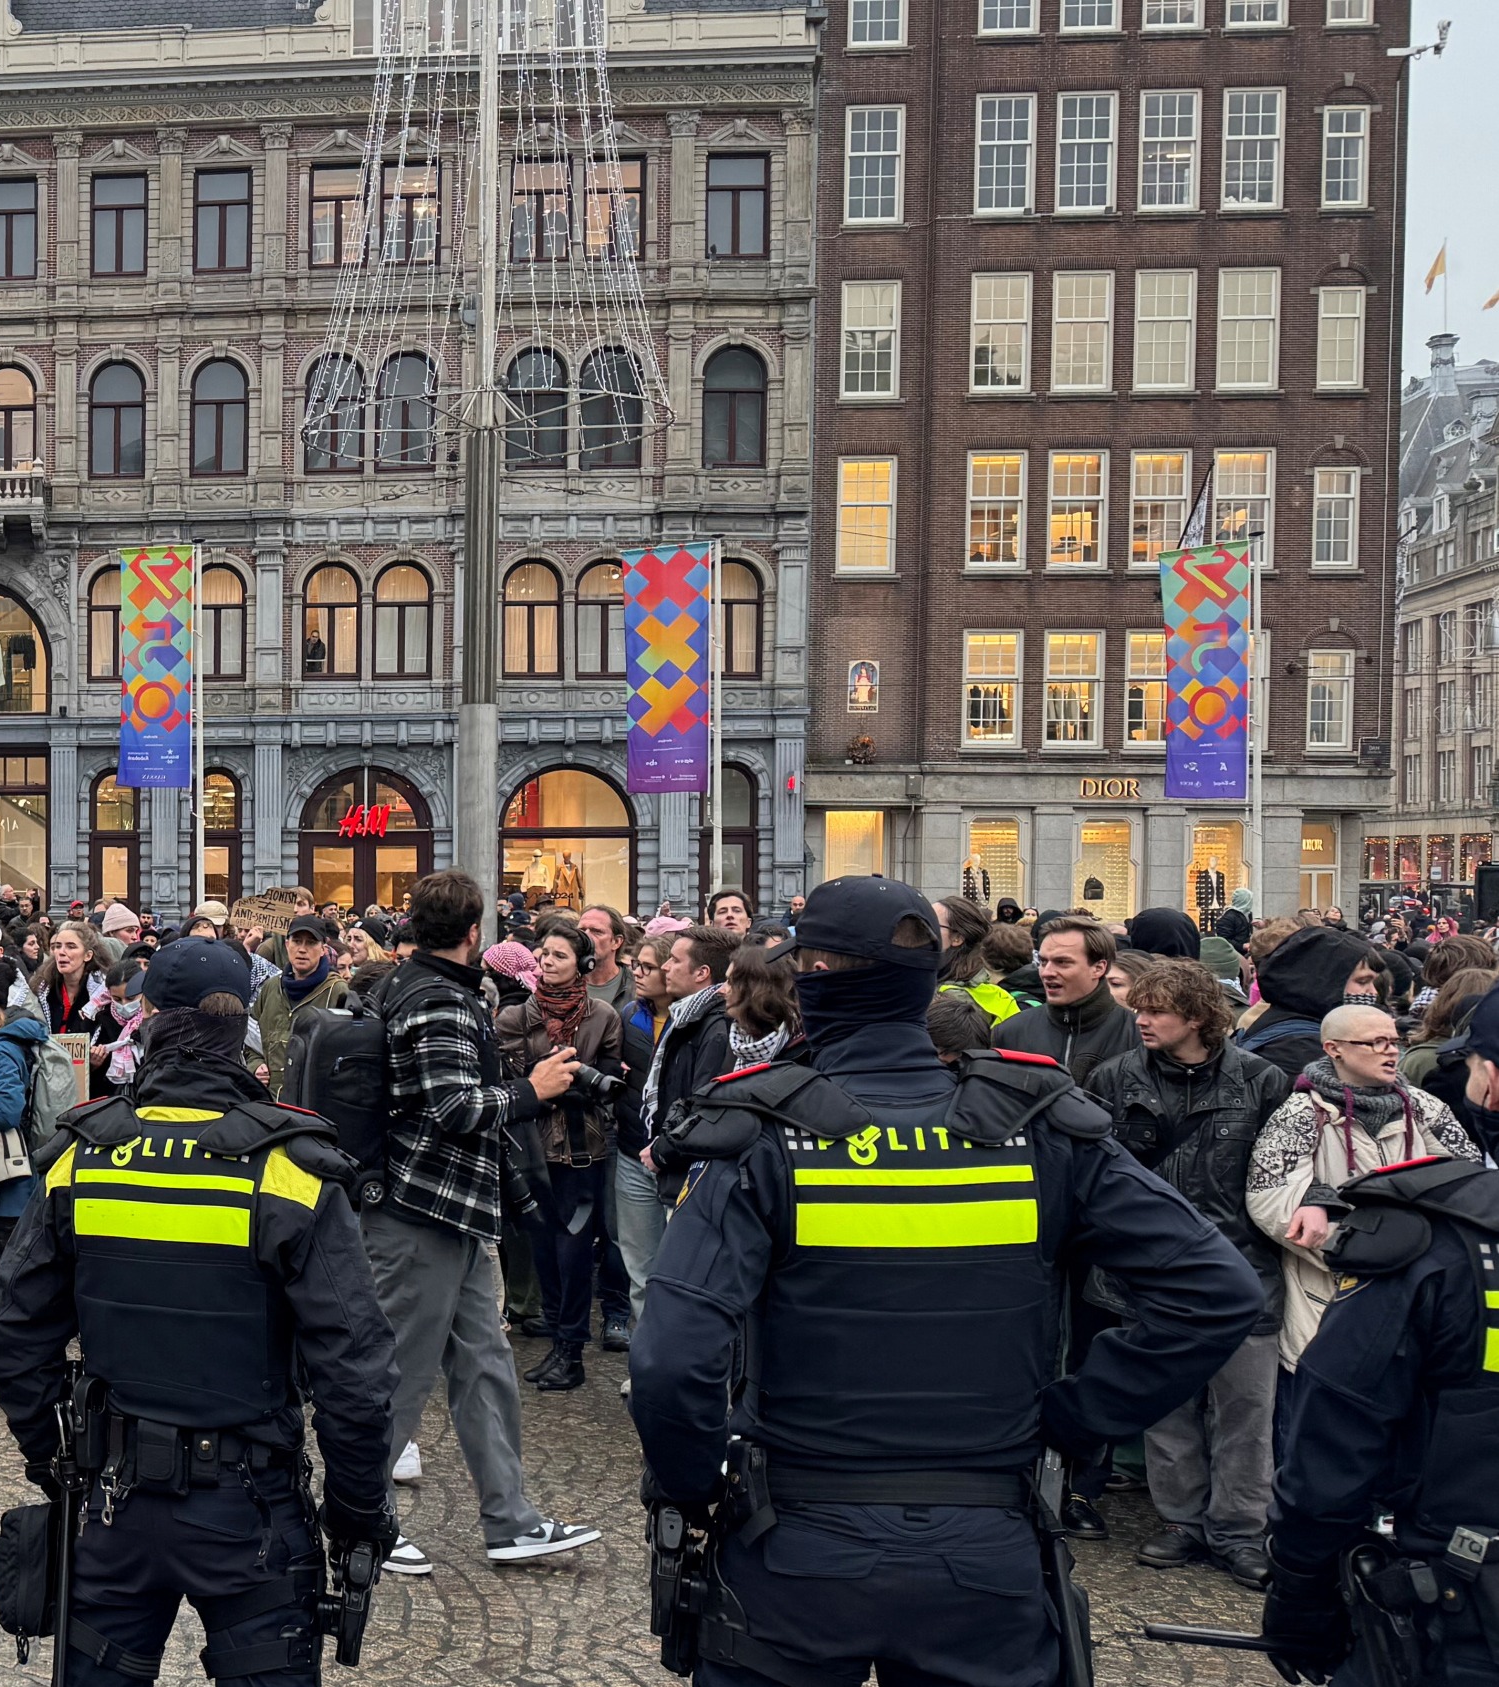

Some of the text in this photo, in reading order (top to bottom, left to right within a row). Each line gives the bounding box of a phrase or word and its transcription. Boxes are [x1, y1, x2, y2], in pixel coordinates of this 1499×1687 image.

[1080, 778, 1142, 797] DIOR
[338, 804, 390, 837] H&M
[1302, 839, 1323, 850] DIOR
[1457, 1534, 1483, 1557] TQ
